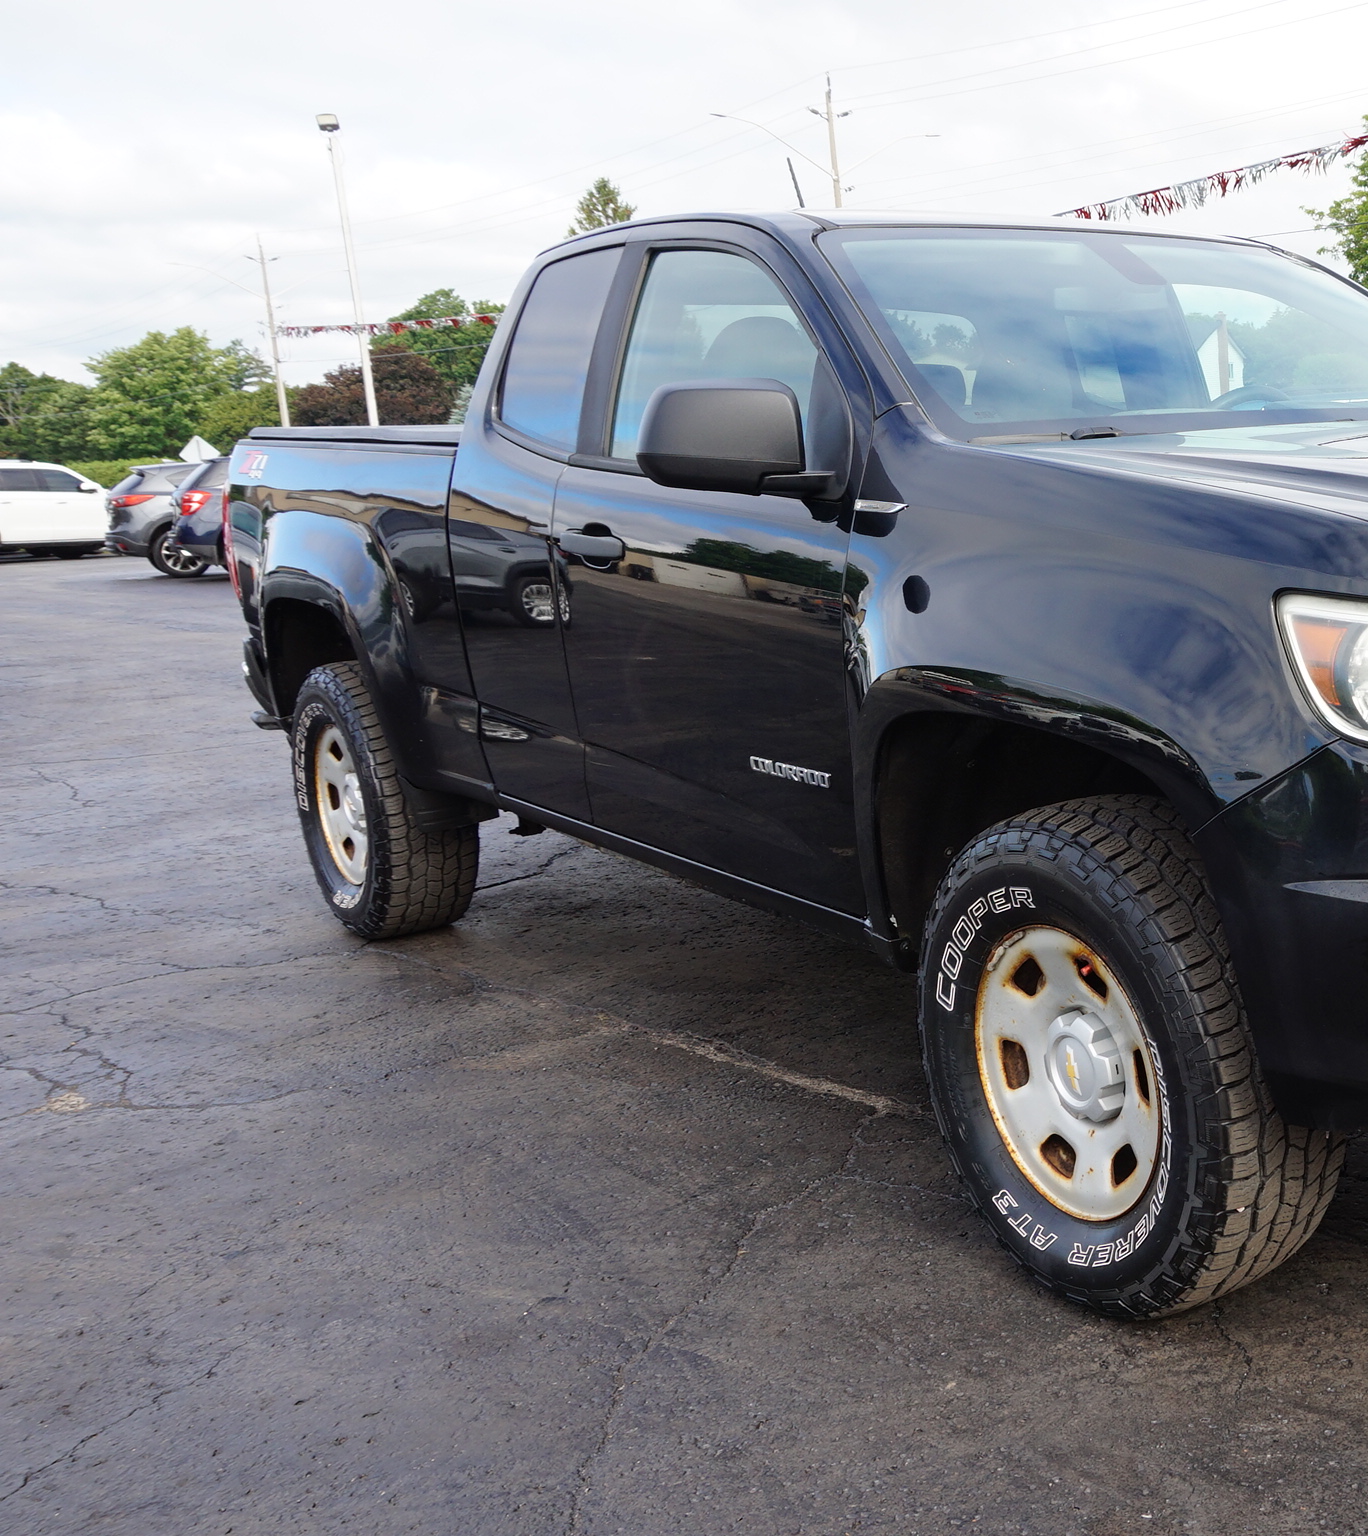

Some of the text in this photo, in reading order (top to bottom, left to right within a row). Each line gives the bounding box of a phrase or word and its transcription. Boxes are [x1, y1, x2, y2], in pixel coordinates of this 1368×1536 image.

[237, 450, 269, 474] Z71
[749, 755, 832, 789] COLORADO
[935, 886, 1036, 1012] COOPER
[1067, 1037, 1173, 1268] DISCOVERER
[991, 1189, 1058, 1251] AT3
